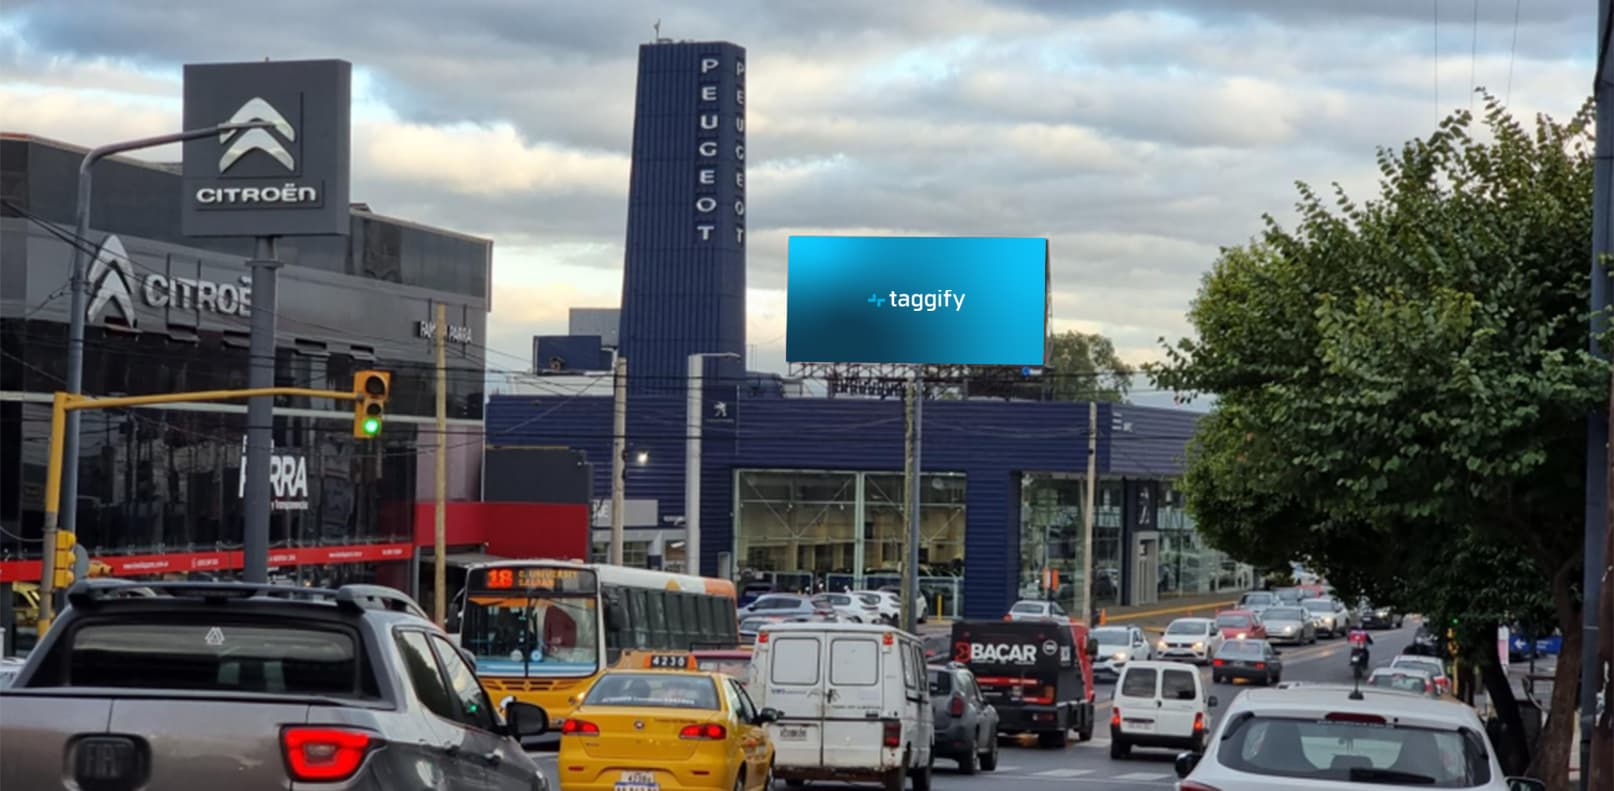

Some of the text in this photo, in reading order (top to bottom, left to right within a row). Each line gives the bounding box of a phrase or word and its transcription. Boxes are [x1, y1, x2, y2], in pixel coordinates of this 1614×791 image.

[696, 58, 719, 240] PEUGEOT
[145, 273, 252, 317] CITROË
[889, 289, 966, 312] taggify
[487, 569, 513, 589] 18
